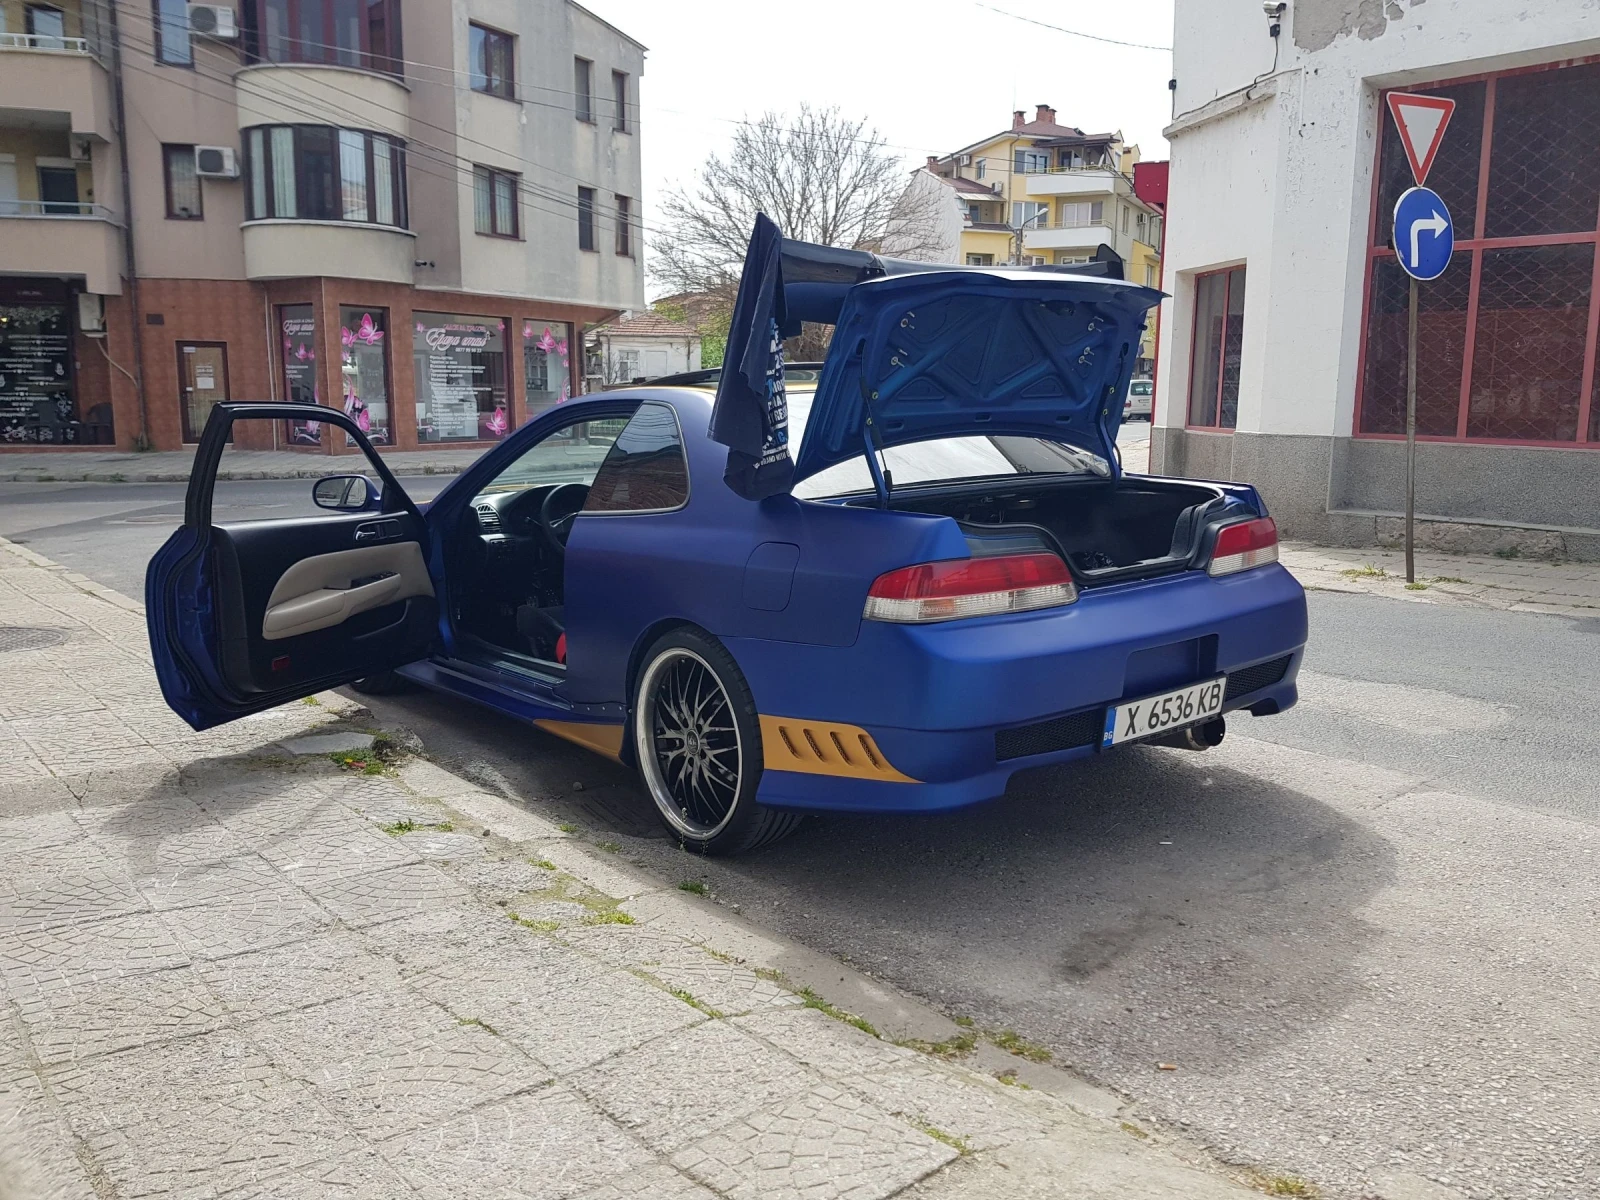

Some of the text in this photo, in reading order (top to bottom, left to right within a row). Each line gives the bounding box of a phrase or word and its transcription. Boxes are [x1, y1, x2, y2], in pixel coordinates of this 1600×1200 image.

[1124, 684, 1220, 737] X 6536 KB
